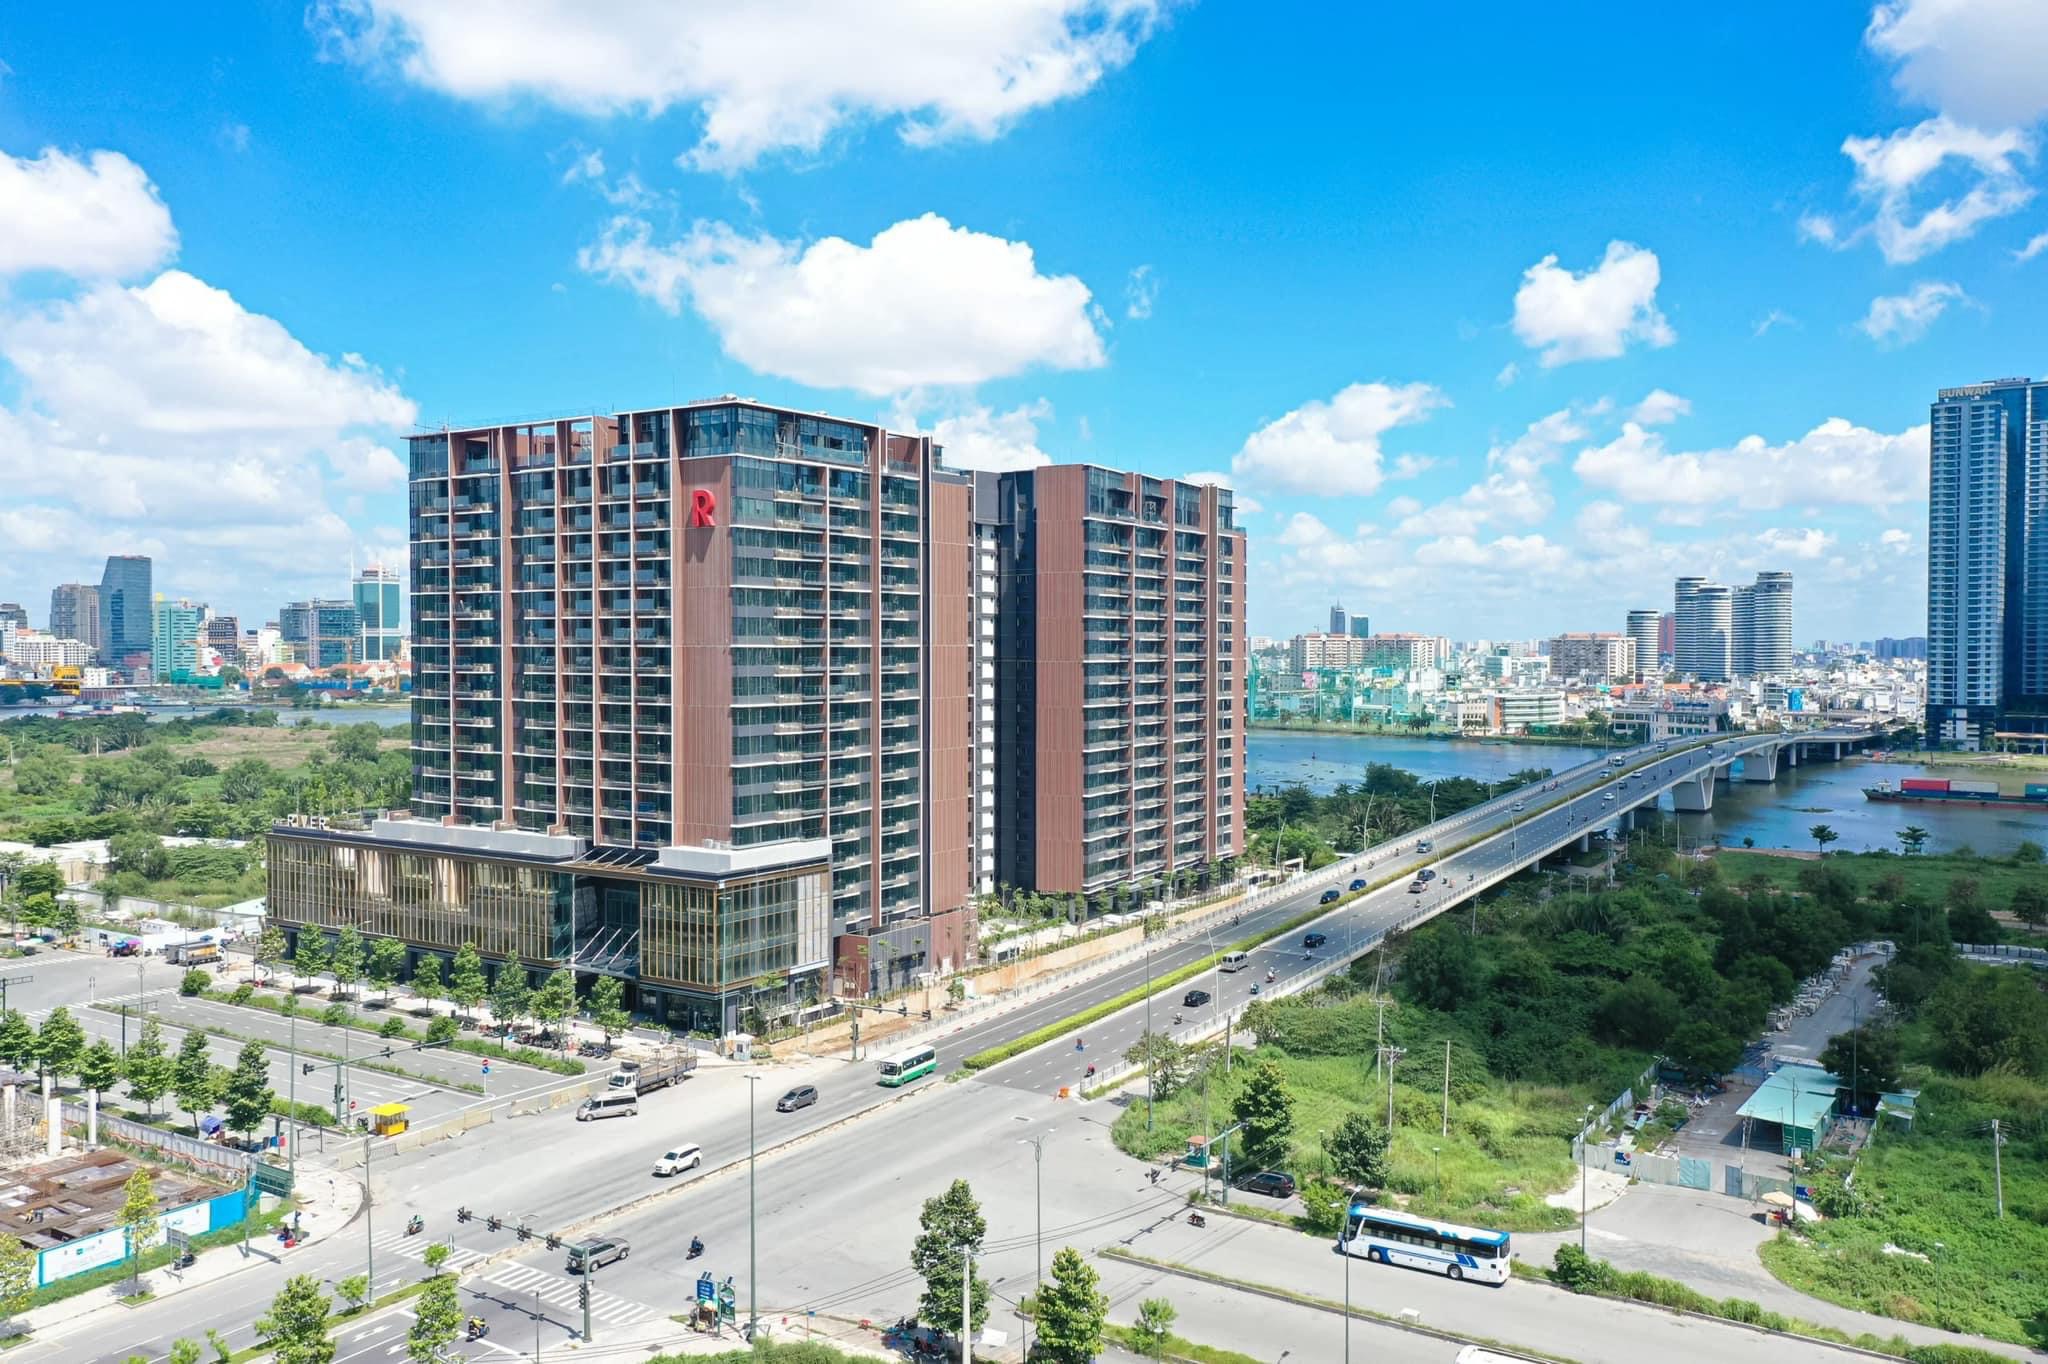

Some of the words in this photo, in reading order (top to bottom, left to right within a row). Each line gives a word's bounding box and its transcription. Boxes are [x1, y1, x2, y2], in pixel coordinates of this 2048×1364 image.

[1940, 386, 1991, 398] SUNWAH
[692, 488, 716, 528] R
[288, 814, 330, 831] RIVER
